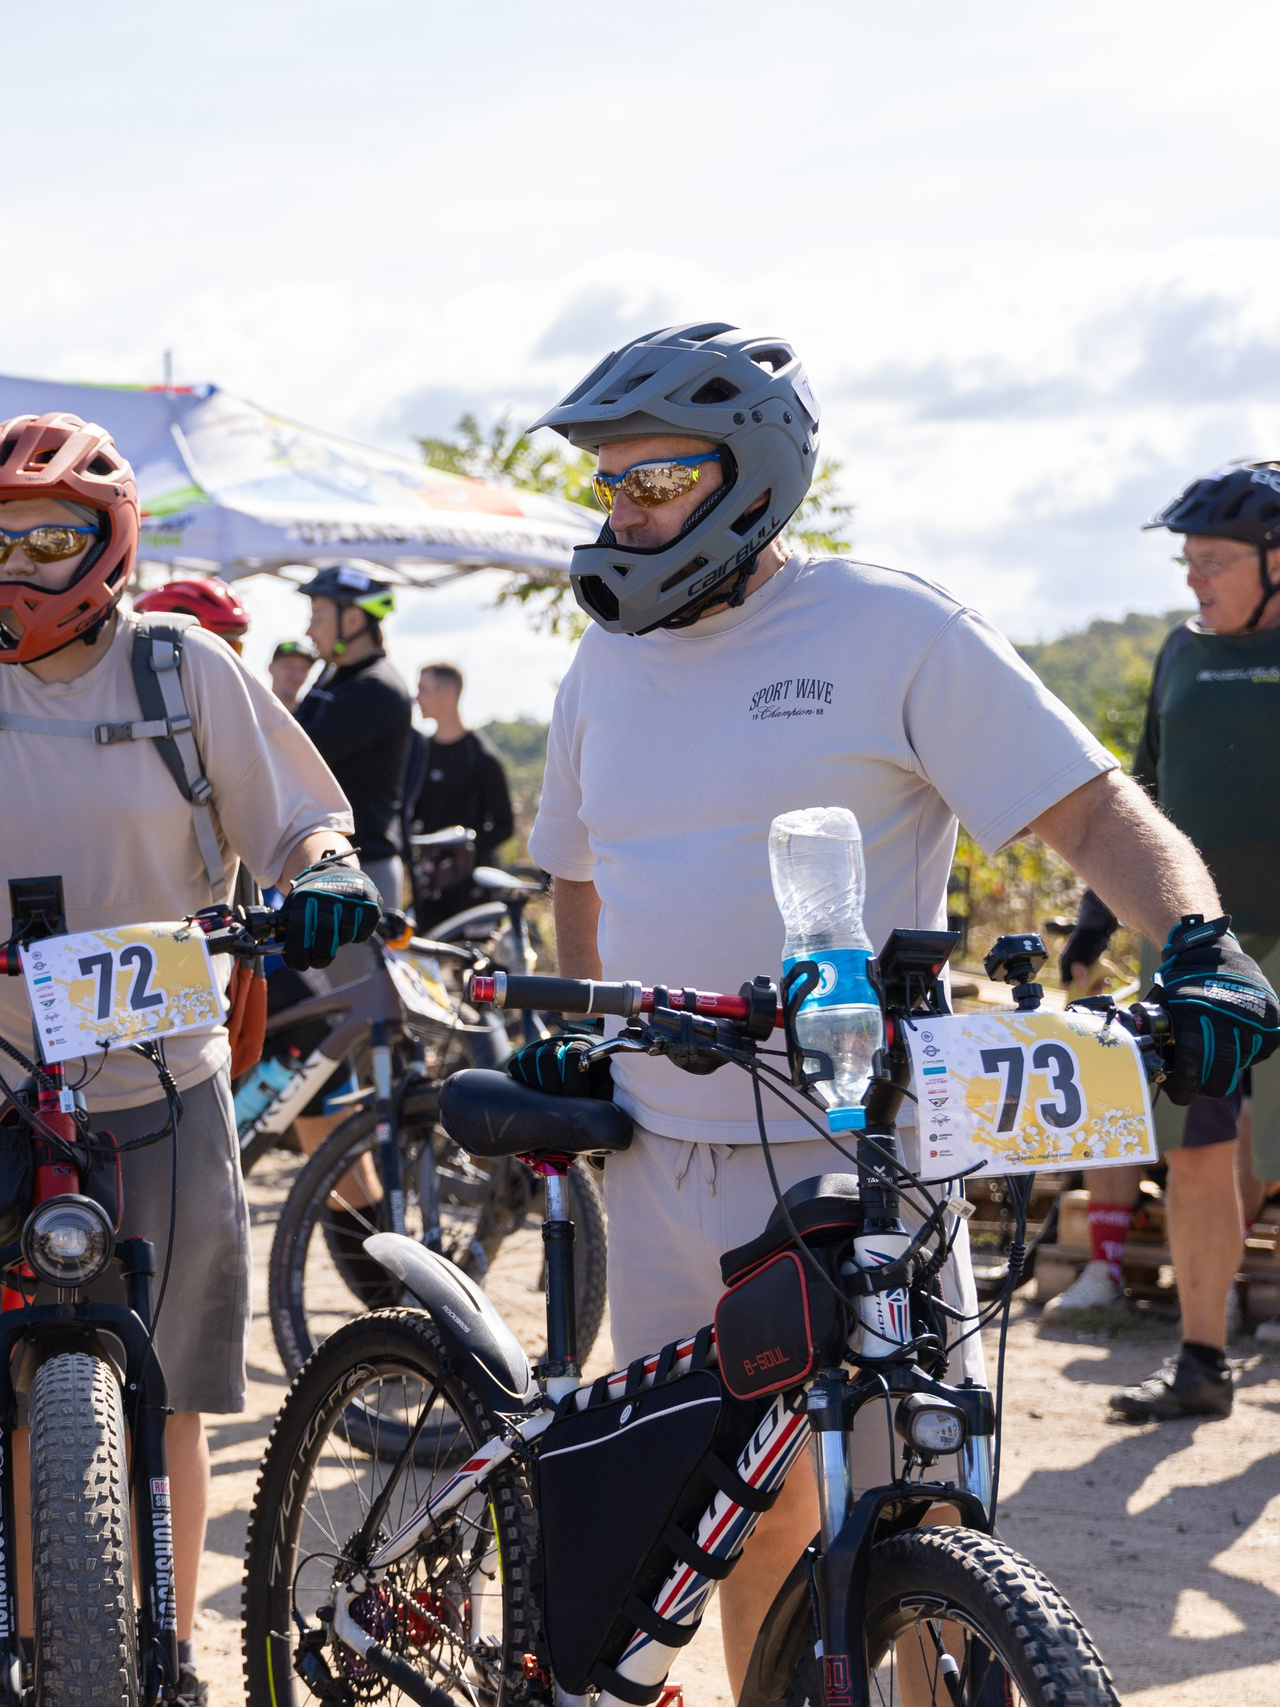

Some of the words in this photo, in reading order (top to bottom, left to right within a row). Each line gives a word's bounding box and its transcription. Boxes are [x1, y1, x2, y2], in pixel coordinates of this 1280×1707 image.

[749, 680, 792, 711] SPORT
[796, 679, 834, 704] WAVE
[757, 705, 814, 720] Champion
[78, 945, 163, 1020] 72
[979, 1043, 1082, 1133] 73
[441, 1304, 471, 1334] ROCKBROS
[743, 1346, 790, 1377] B-SOUL
